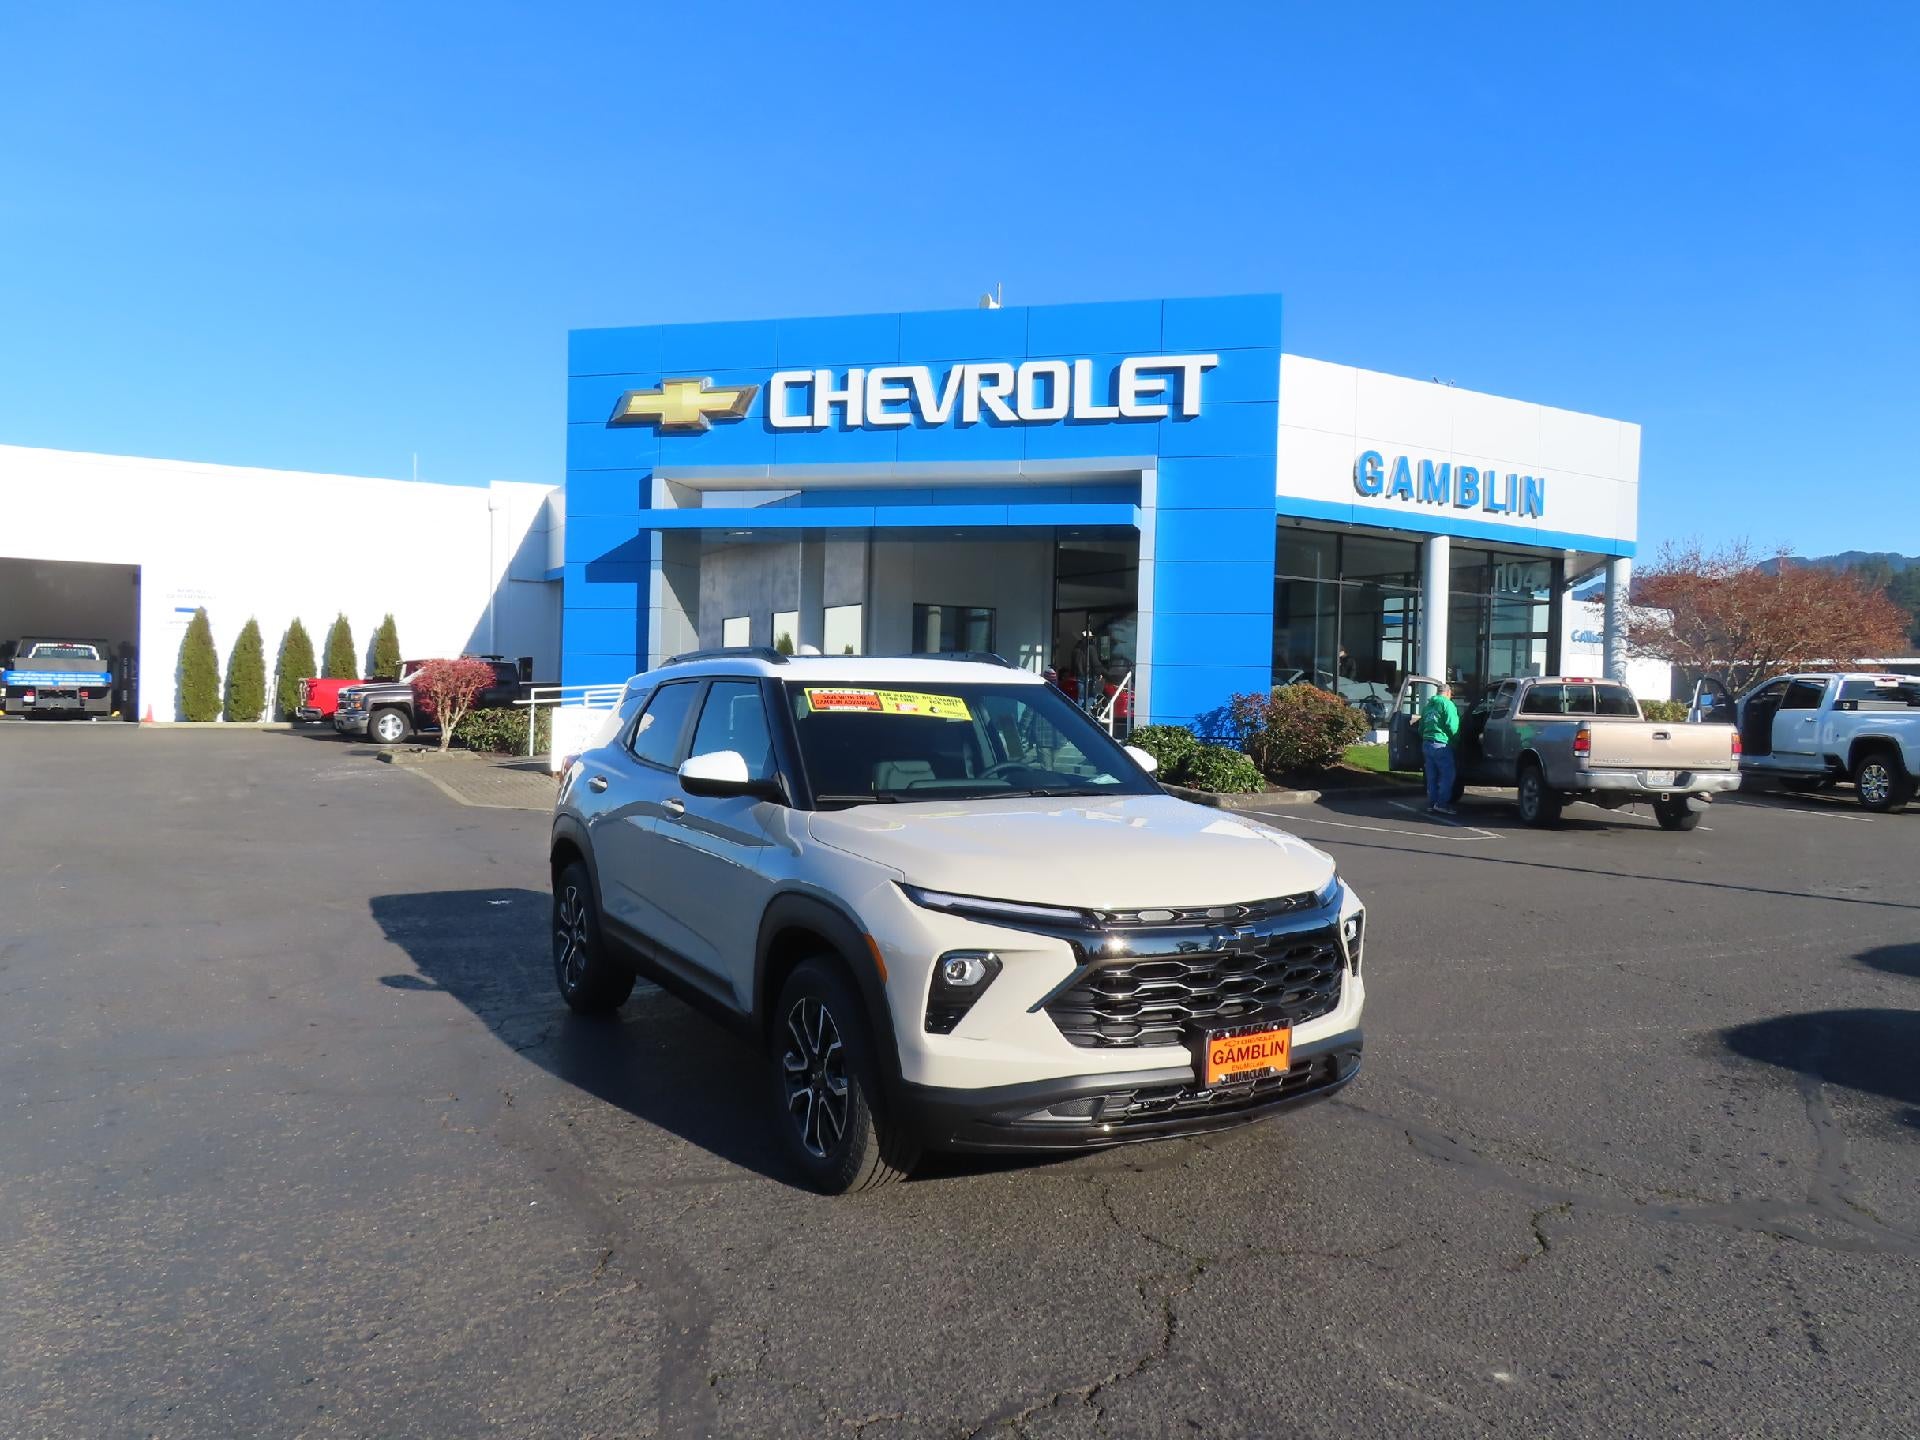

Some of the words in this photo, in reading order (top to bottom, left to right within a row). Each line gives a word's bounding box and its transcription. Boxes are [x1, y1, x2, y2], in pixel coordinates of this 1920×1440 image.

[768, 354, 1219, 429] CHEVROLET
[1353, 450, 1545, 519] GAMBLIN
[1213, 1040, 1285, 1065] GAMBLIN
